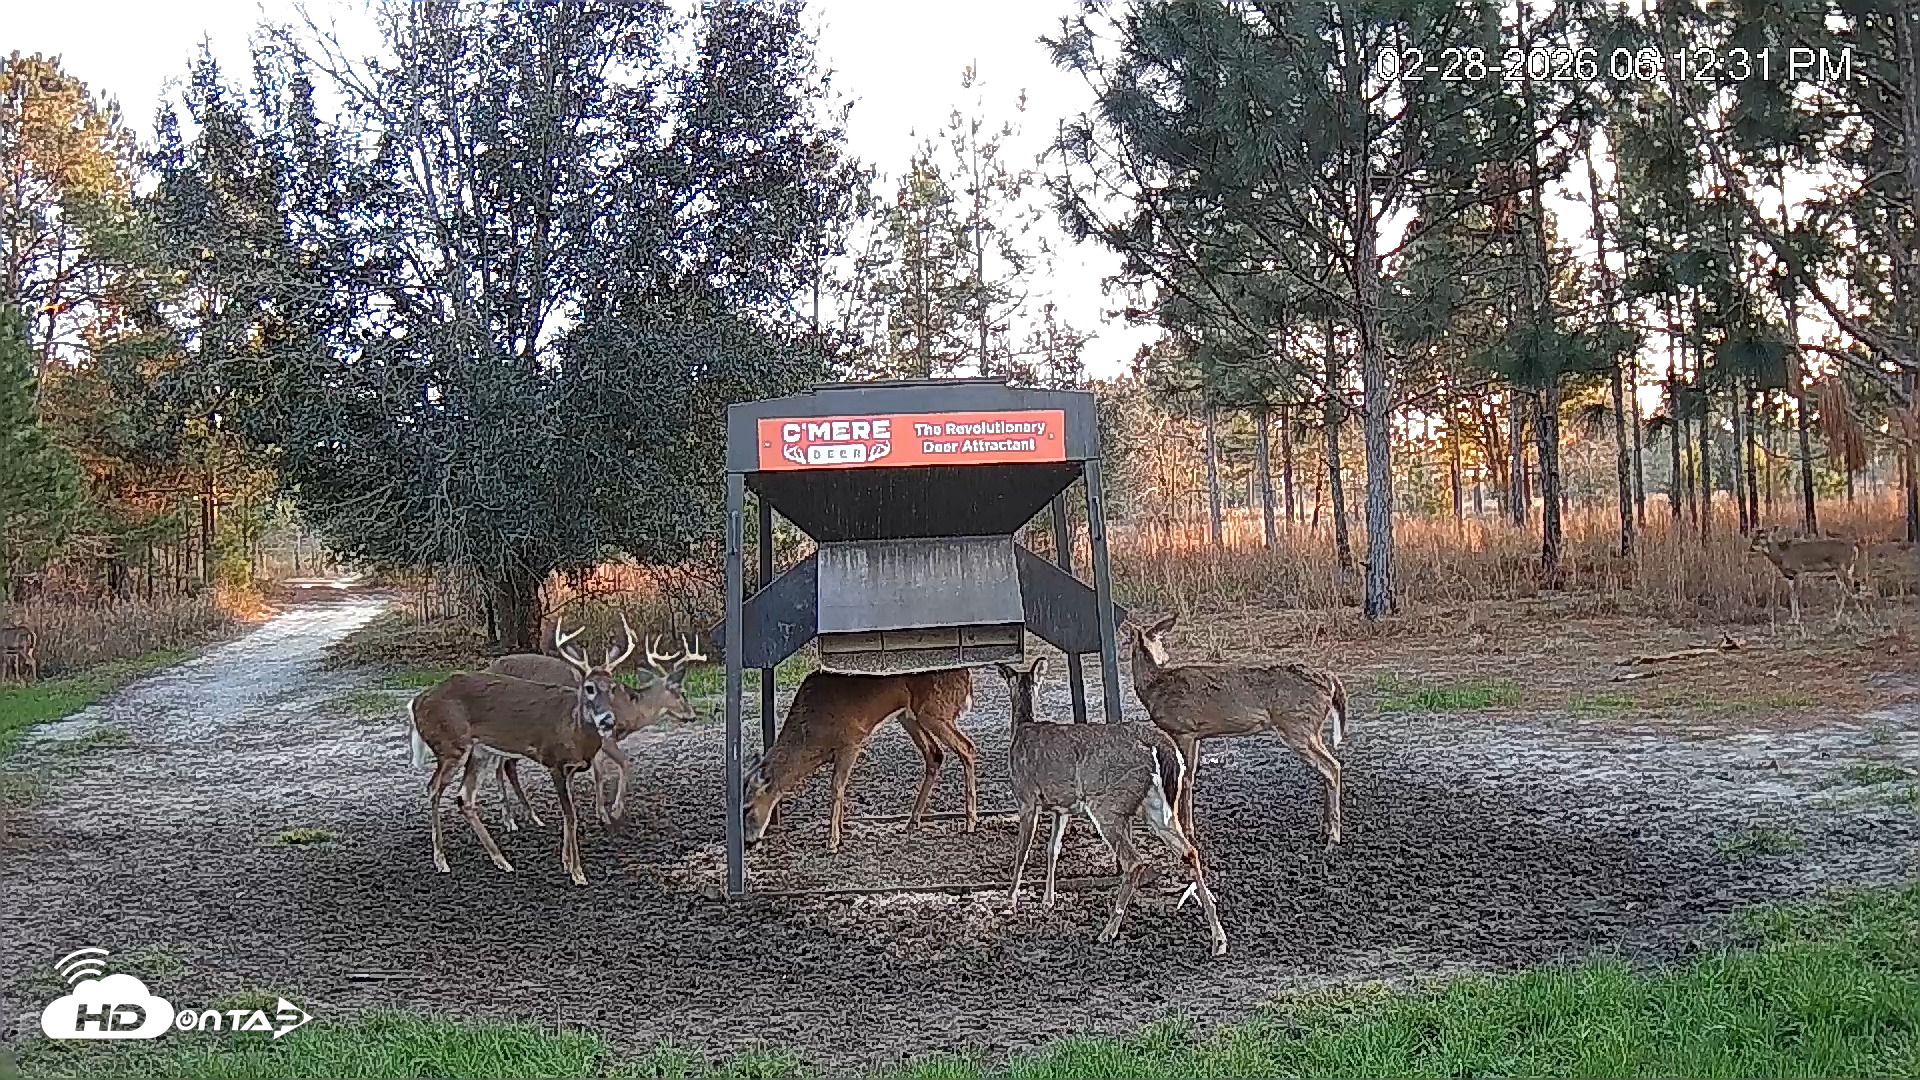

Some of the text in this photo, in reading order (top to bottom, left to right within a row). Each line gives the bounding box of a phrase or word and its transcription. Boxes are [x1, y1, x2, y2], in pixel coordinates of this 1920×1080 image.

[783, 420, 891, 442] C'MERE
[914, 420, 1046, 436] The Revolutionary
[923, 438, 1036, 453] Deer Attractant
[812, 448, 862, 460] DEER
